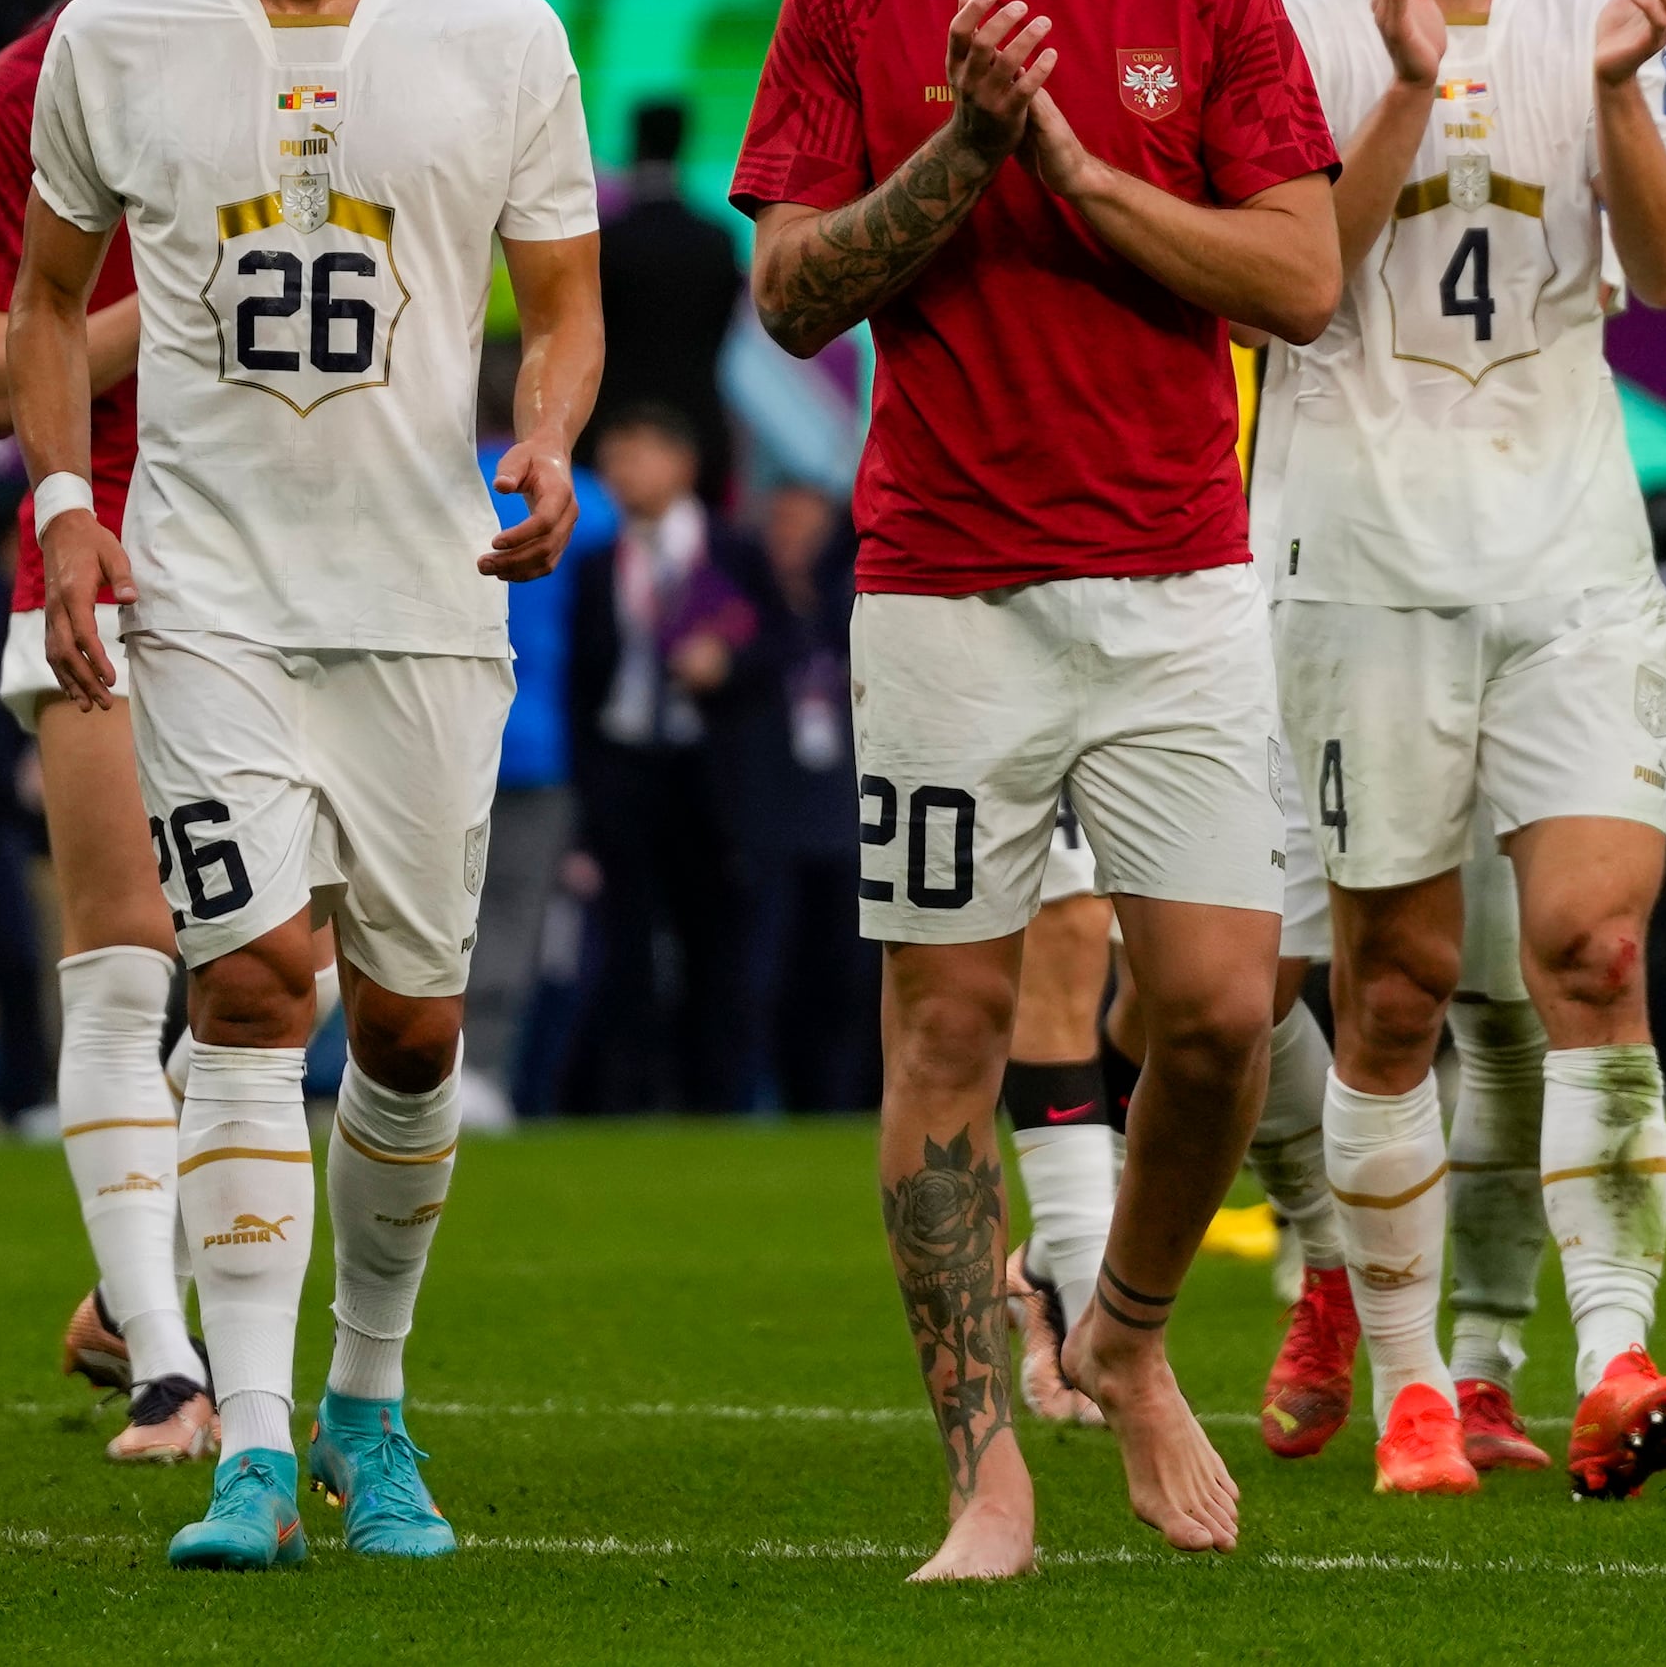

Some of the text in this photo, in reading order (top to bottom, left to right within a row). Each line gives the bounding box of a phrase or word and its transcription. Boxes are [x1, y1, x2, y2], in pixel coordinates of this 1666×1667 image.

[279, 137, 328, 156] PUMA
[924, 85, 954, 102] PU
[236, 249, 376, 374] 26
[1439, 227, 1495, 341] 4
[859, 773, 976, 910] 20
[1318, 738, 1347, 853] 4
[203, 1229, 272, 1250] PUMA
